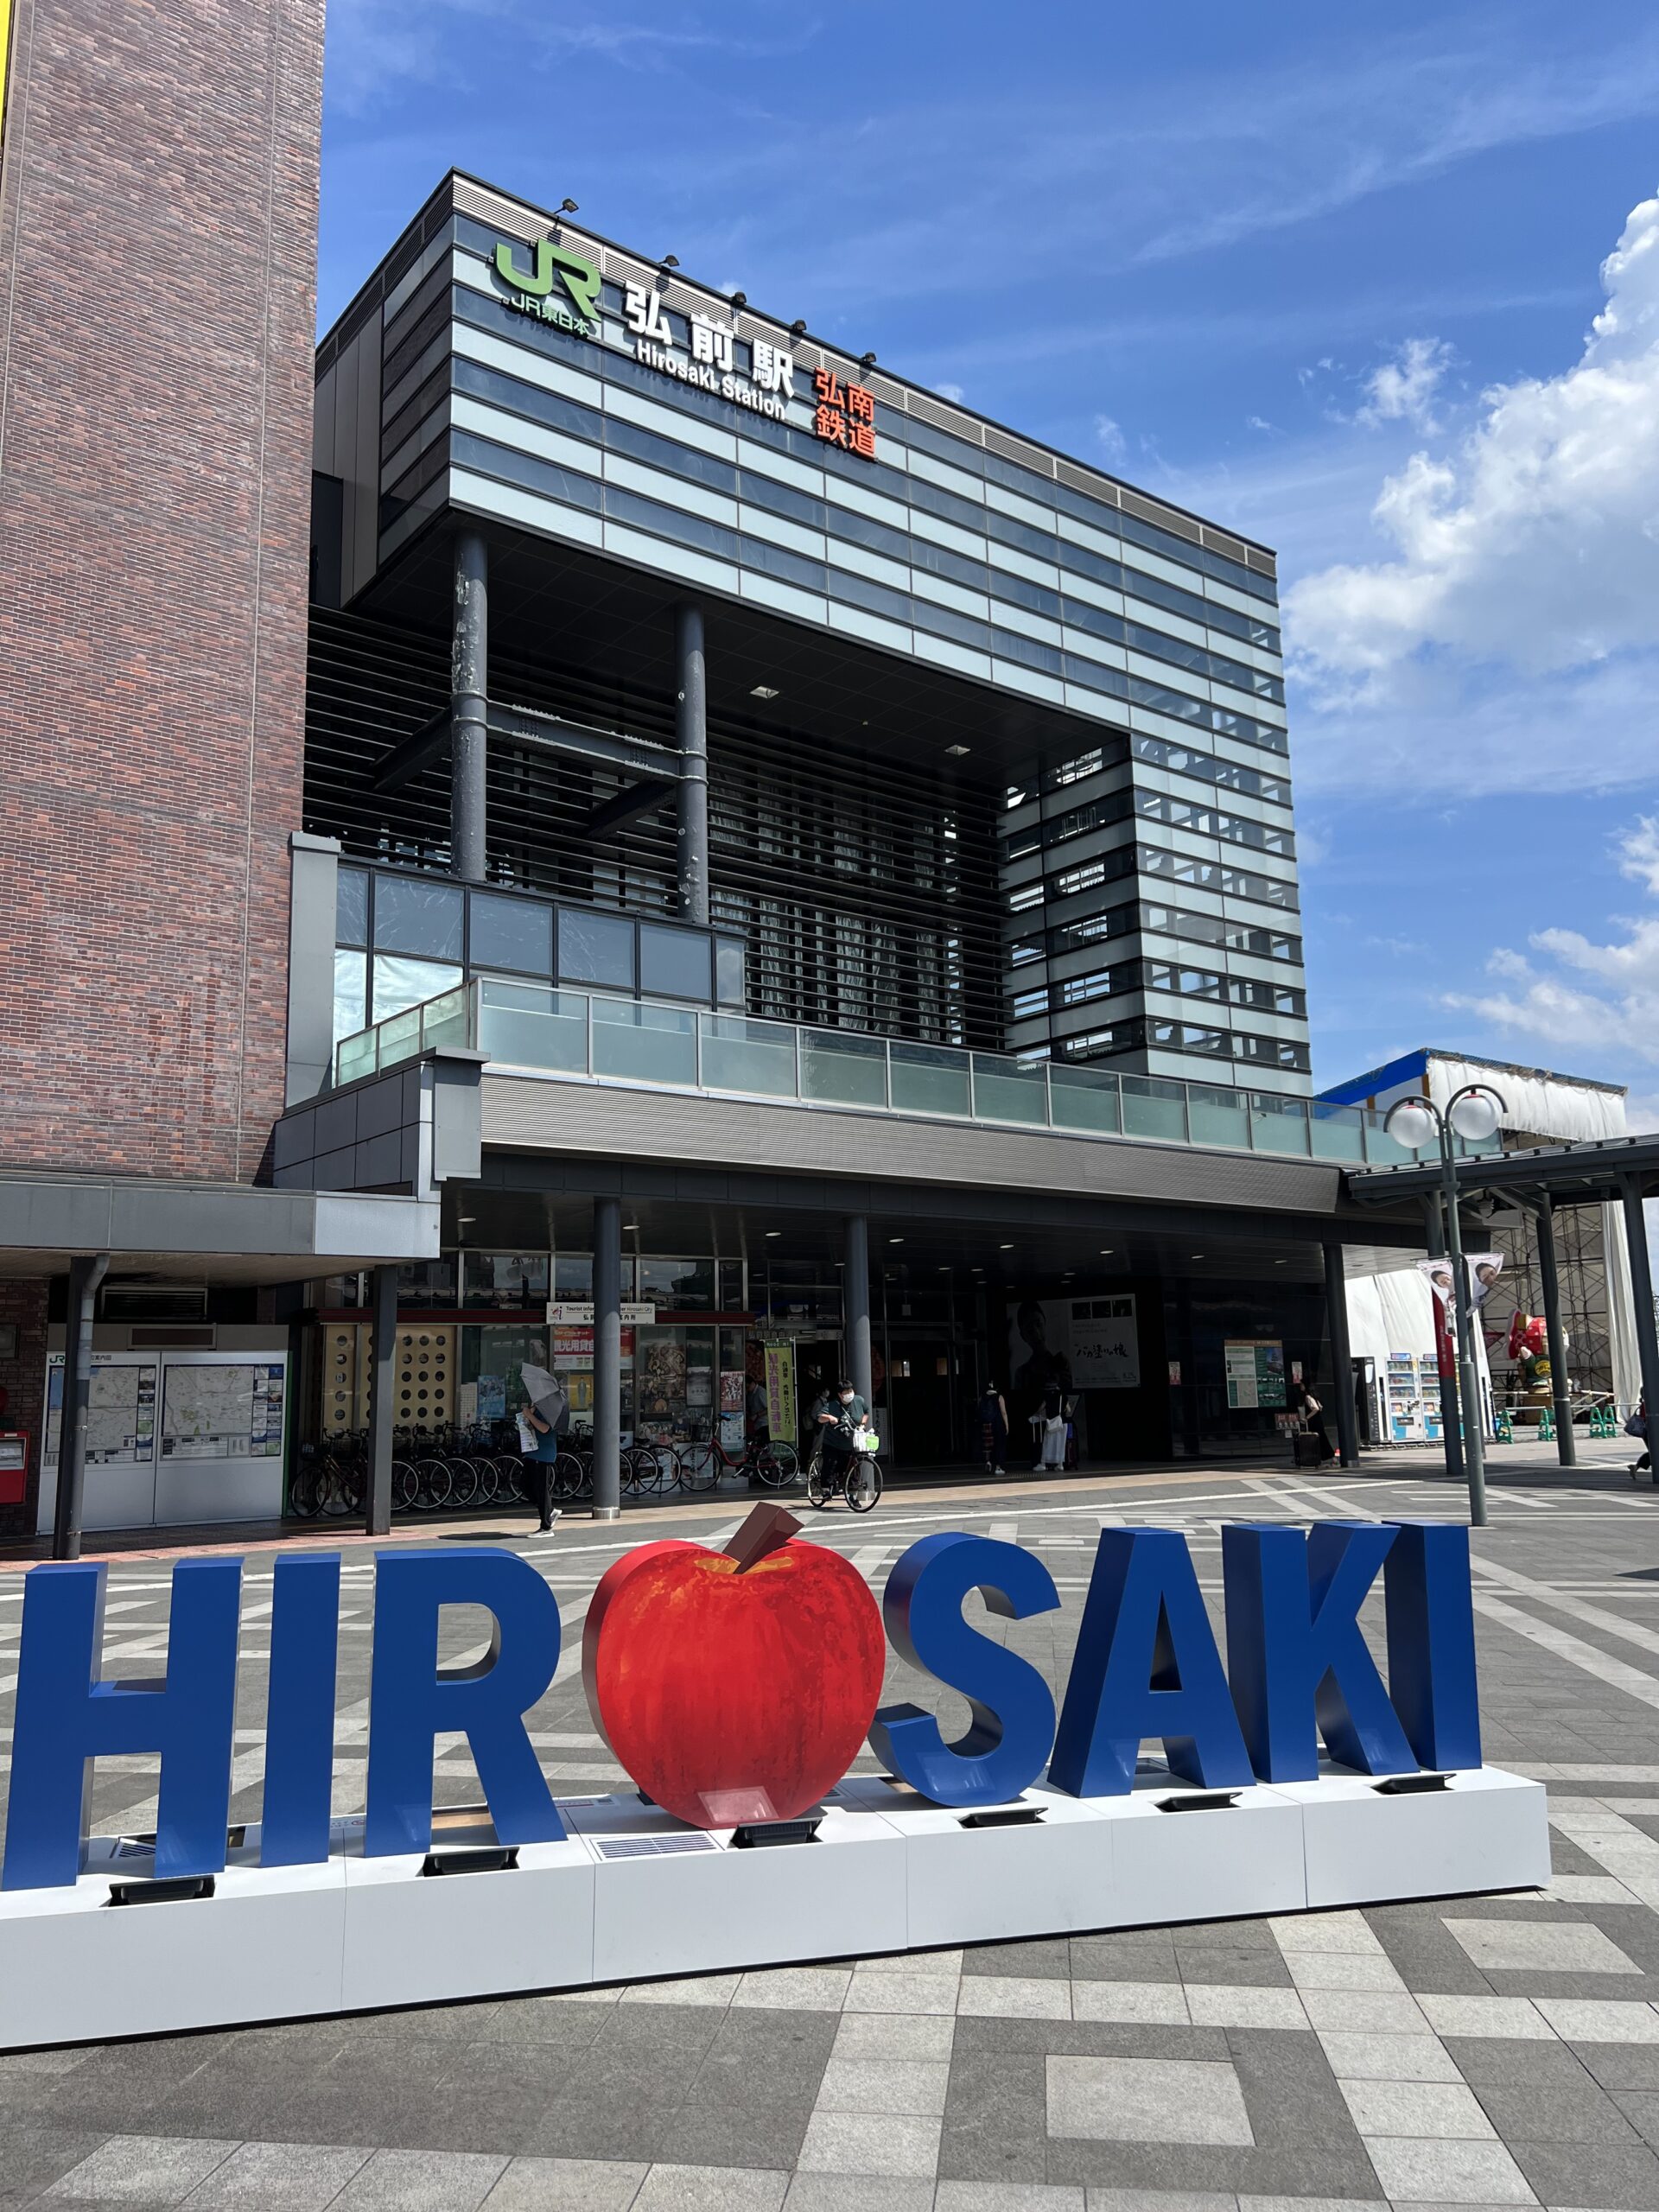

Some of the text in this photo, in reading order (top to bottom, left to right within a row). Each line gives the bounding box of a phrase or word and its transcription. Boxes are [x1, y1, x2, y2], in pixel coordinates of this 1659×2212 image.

[496, 238, 602, 322] JR
[511, 293, 592, 337] JR東日本
[625, 279, 795, 398] 弘前駅
[637, 338, 785, 421] Hirosaki Station
[815, 366, 876, 423] 弘南
[817, 404, 877, 460] 鉄道
[49, 1355, 65, 1363] JR
